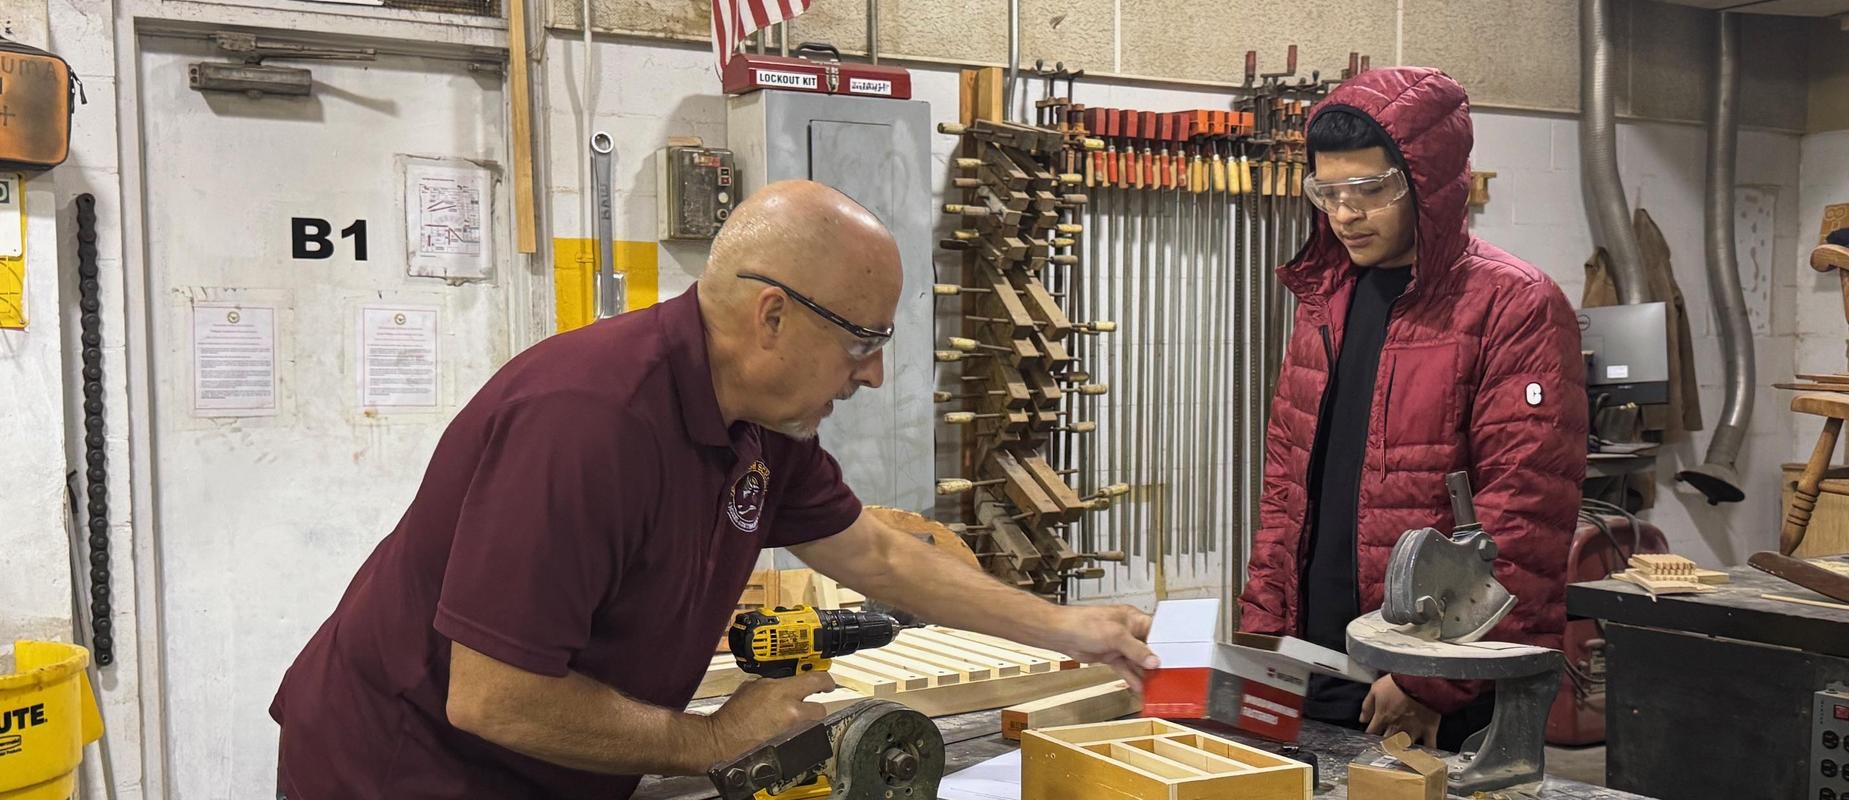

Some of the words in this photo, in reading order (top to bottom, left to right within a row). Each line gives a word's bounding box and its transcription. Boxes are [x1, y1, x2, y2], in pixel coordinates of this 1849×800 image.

[759, 73, 800, 85] LOCKOUT
[802, 76, 816, 86] KIT
[291, 217, 368, 261] B1
